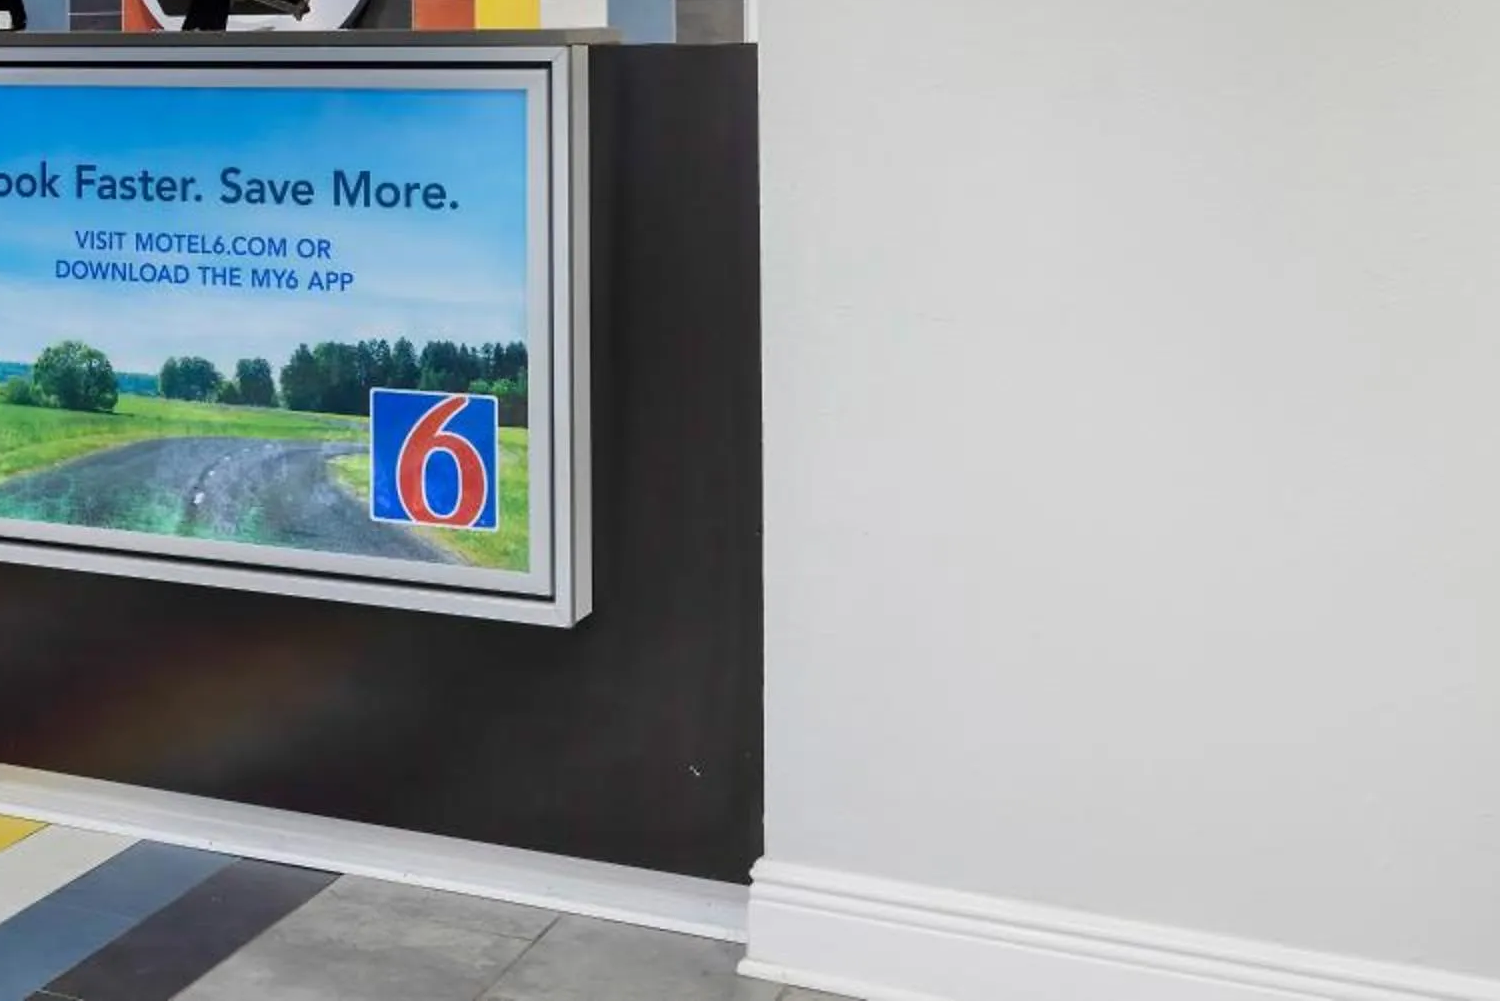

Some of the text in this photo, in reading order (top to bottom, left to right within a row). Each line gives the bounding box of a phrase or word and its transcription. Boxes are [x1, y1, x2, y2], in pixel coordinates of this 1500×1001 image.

[75, 164, 203, 203] Faster.
[220, 167, 316, 207] Save
[333, 170, 461, 212] More.
[75, 230, 332, 261] VISIT MOTEL6.COM OR
[55, 260, 354, 293] DOWNLOAD THE MY6 APP
[395, 394, 489, 529] 6
